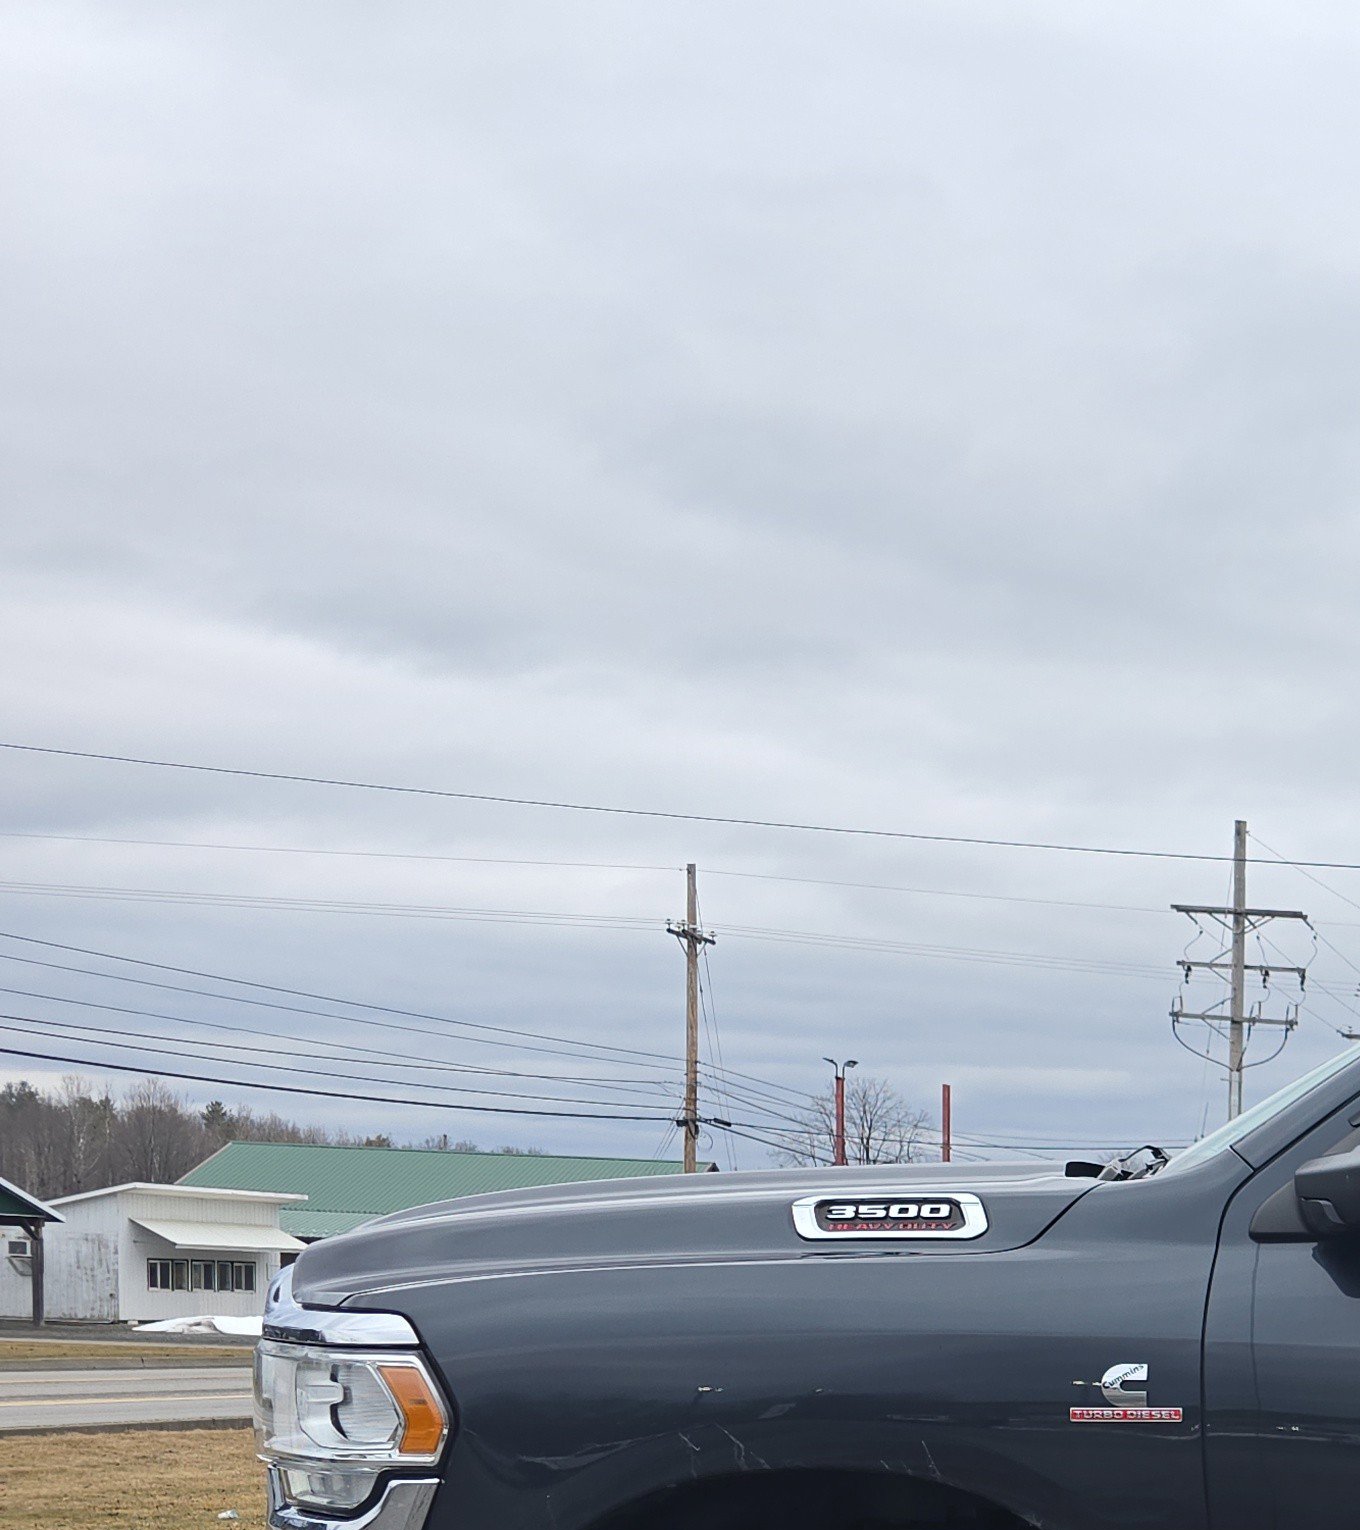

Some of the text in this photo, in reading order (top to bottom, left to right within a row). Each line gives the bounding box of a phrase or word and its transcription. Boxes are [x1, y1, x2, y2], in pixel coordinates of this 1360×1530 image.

[826, 1203, 951, 1219] 3500
[1102, 1364, 1145, 1389] Cummins
[1072, 1410, 1180, 1419] TURBO DIESEL
